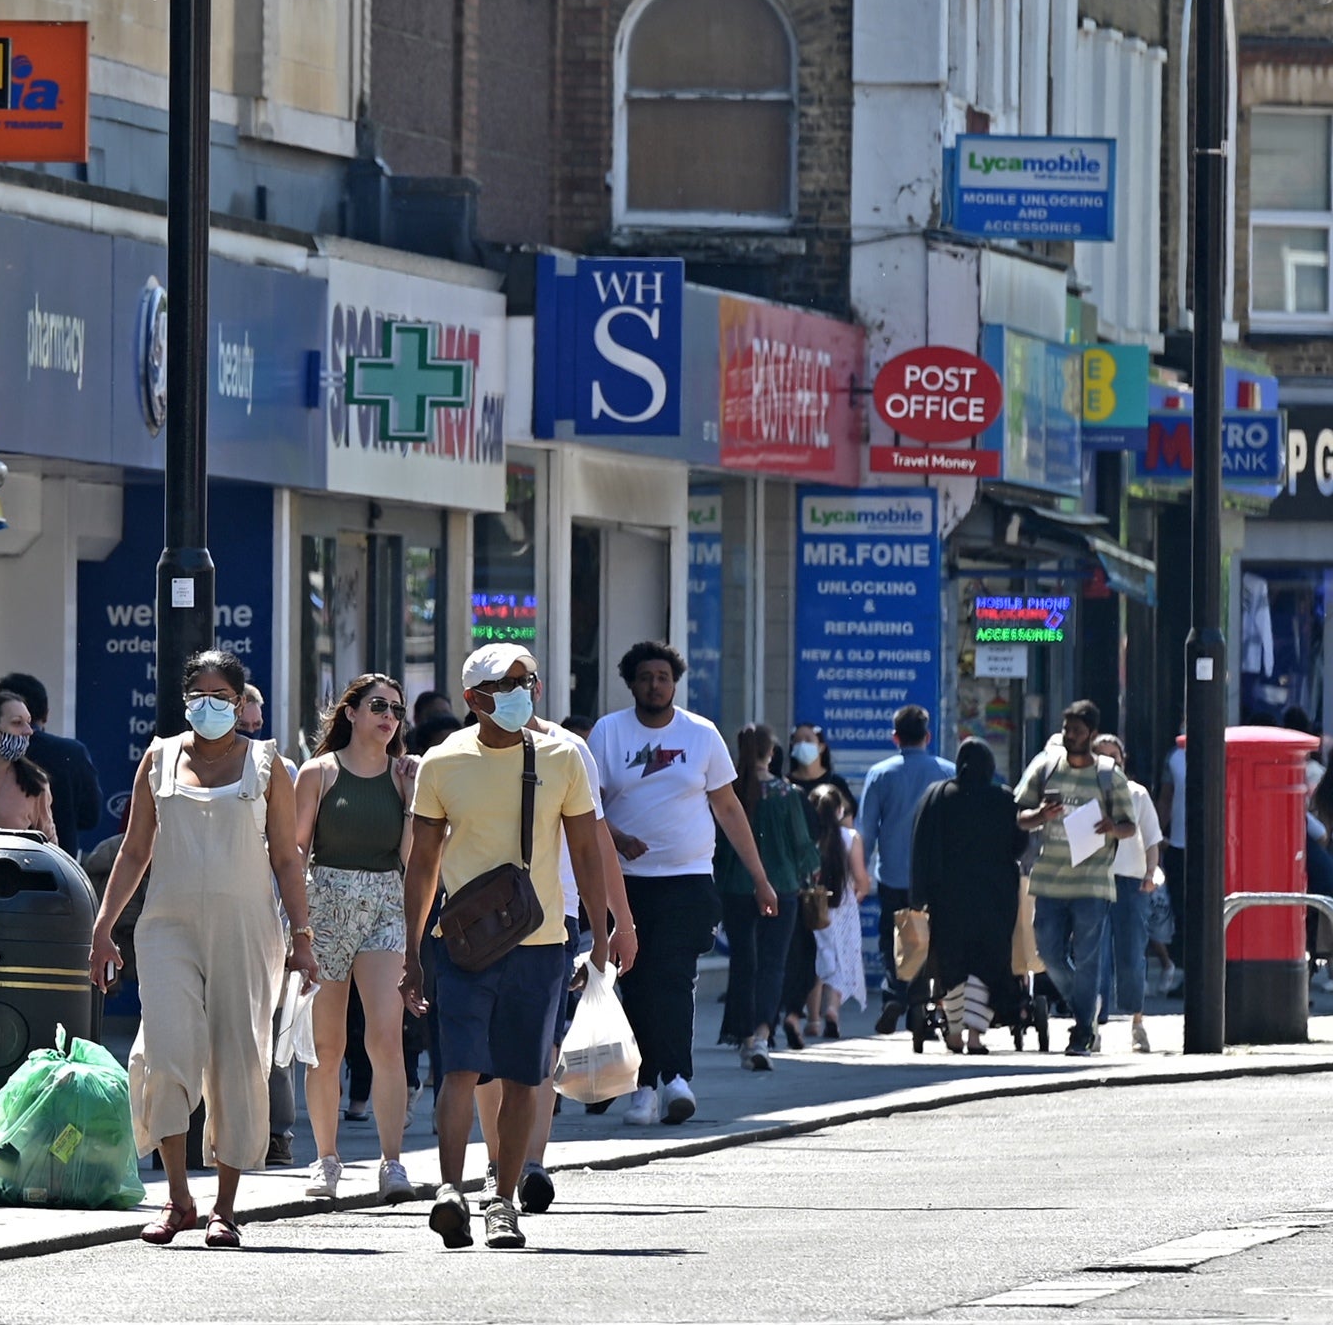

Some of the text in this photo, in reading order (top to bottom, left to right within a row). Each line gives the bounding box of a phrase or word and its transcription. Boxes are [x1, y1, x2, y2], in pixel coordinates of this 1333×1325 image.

[10, 55, 61, 111] ia
[967, 149, 1101, 176] Lycamobile
[963, 194, 1103, 208] MOBILE UNLOCKING
[1018, 208, 1047, 220] AND
[984, 221, 1081, 235] ACCESSORIES
[592, 272, 663, 304] WH
[27, 293, 85, 391] pharmacy
[217, 323, 254, 415] beauty
[592, 305, 667, 423] S
[904, 364, 977, 393] POST
[885, 393, 986, 424] OFFICE
[892, 452, 976, 473] Travel Money
[810, 502, 924, 528] Lycamobile
[802, 543, 930, 567] MR.FONE
[817, 580, 917, 596] UNLOCKING
[824, 621, 914, 636] REPAIRING
[801, 649, 832, 661] NEW
[878, 650, 931, 663] PHONES
[816, 668, 917, 681] ACCESSORIES
[823, 687, 908, 701] JEWELLERY
[824, 707, 894, 721] HANDBAG
